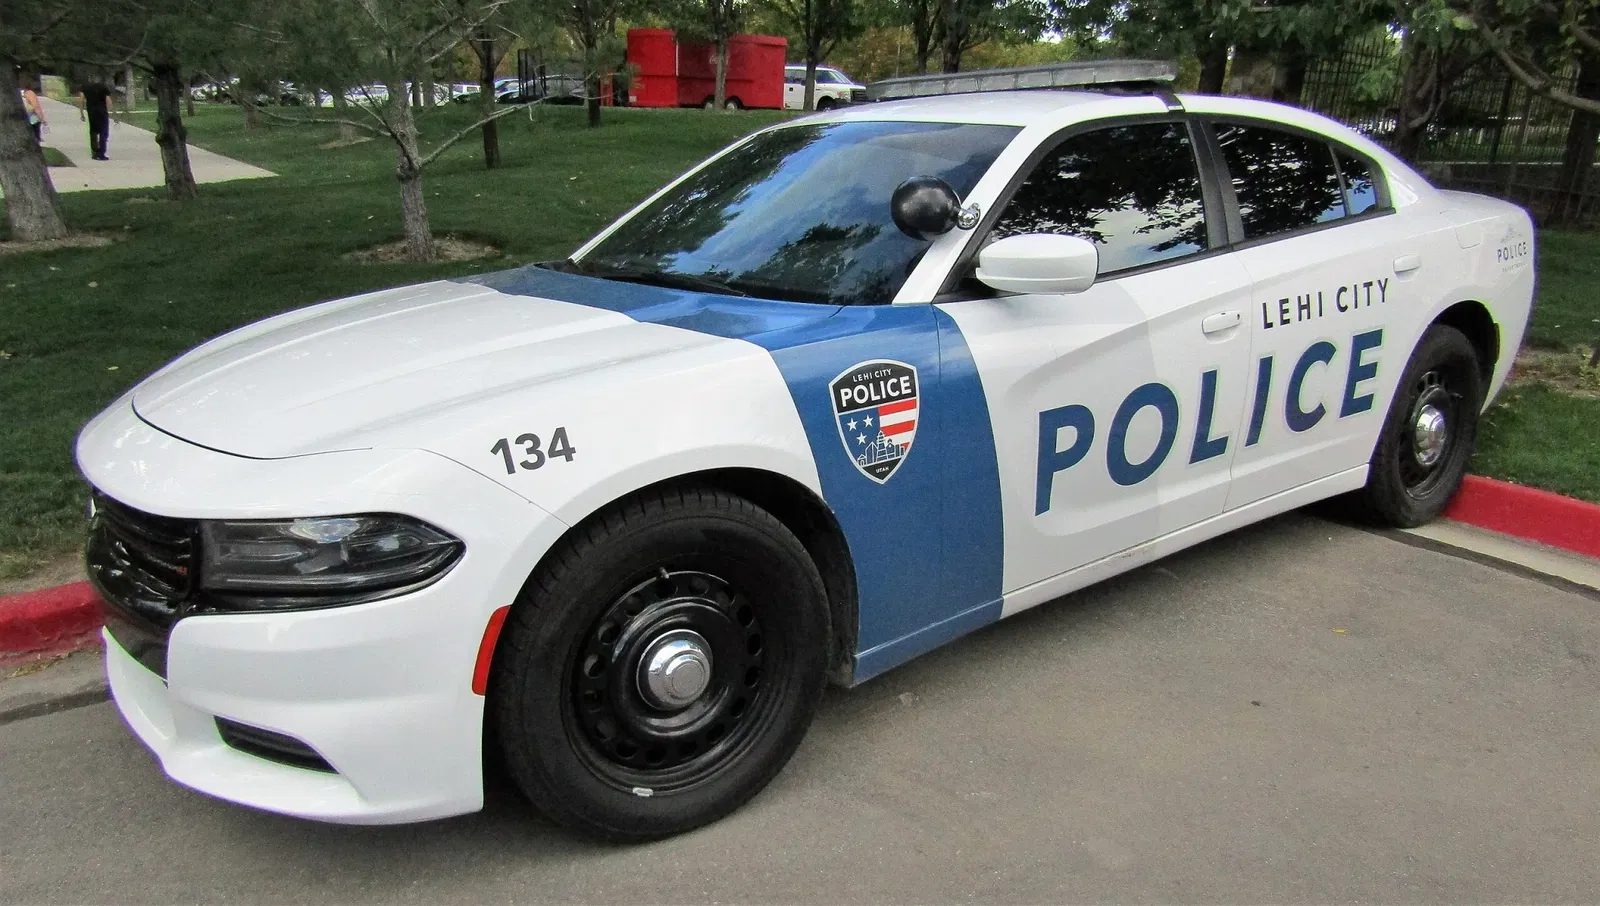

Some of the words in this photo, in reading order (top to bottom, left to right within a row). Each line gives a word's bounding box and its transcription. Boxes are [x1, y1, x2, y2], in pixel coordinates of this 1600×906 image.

[1497, 241, 1527, 263] POLICE
[1262, 291, 1323, 329] LEHI
[1336, 277, 1389, 313] CITY
[840, 375, 912, 408] POLICE
[853, 372, 873, 383] LEHI
[874, 368, 892, 378] CITY
[1035, 328, 1384, 516] POLICE
[490, 426, 577, 475] 134
